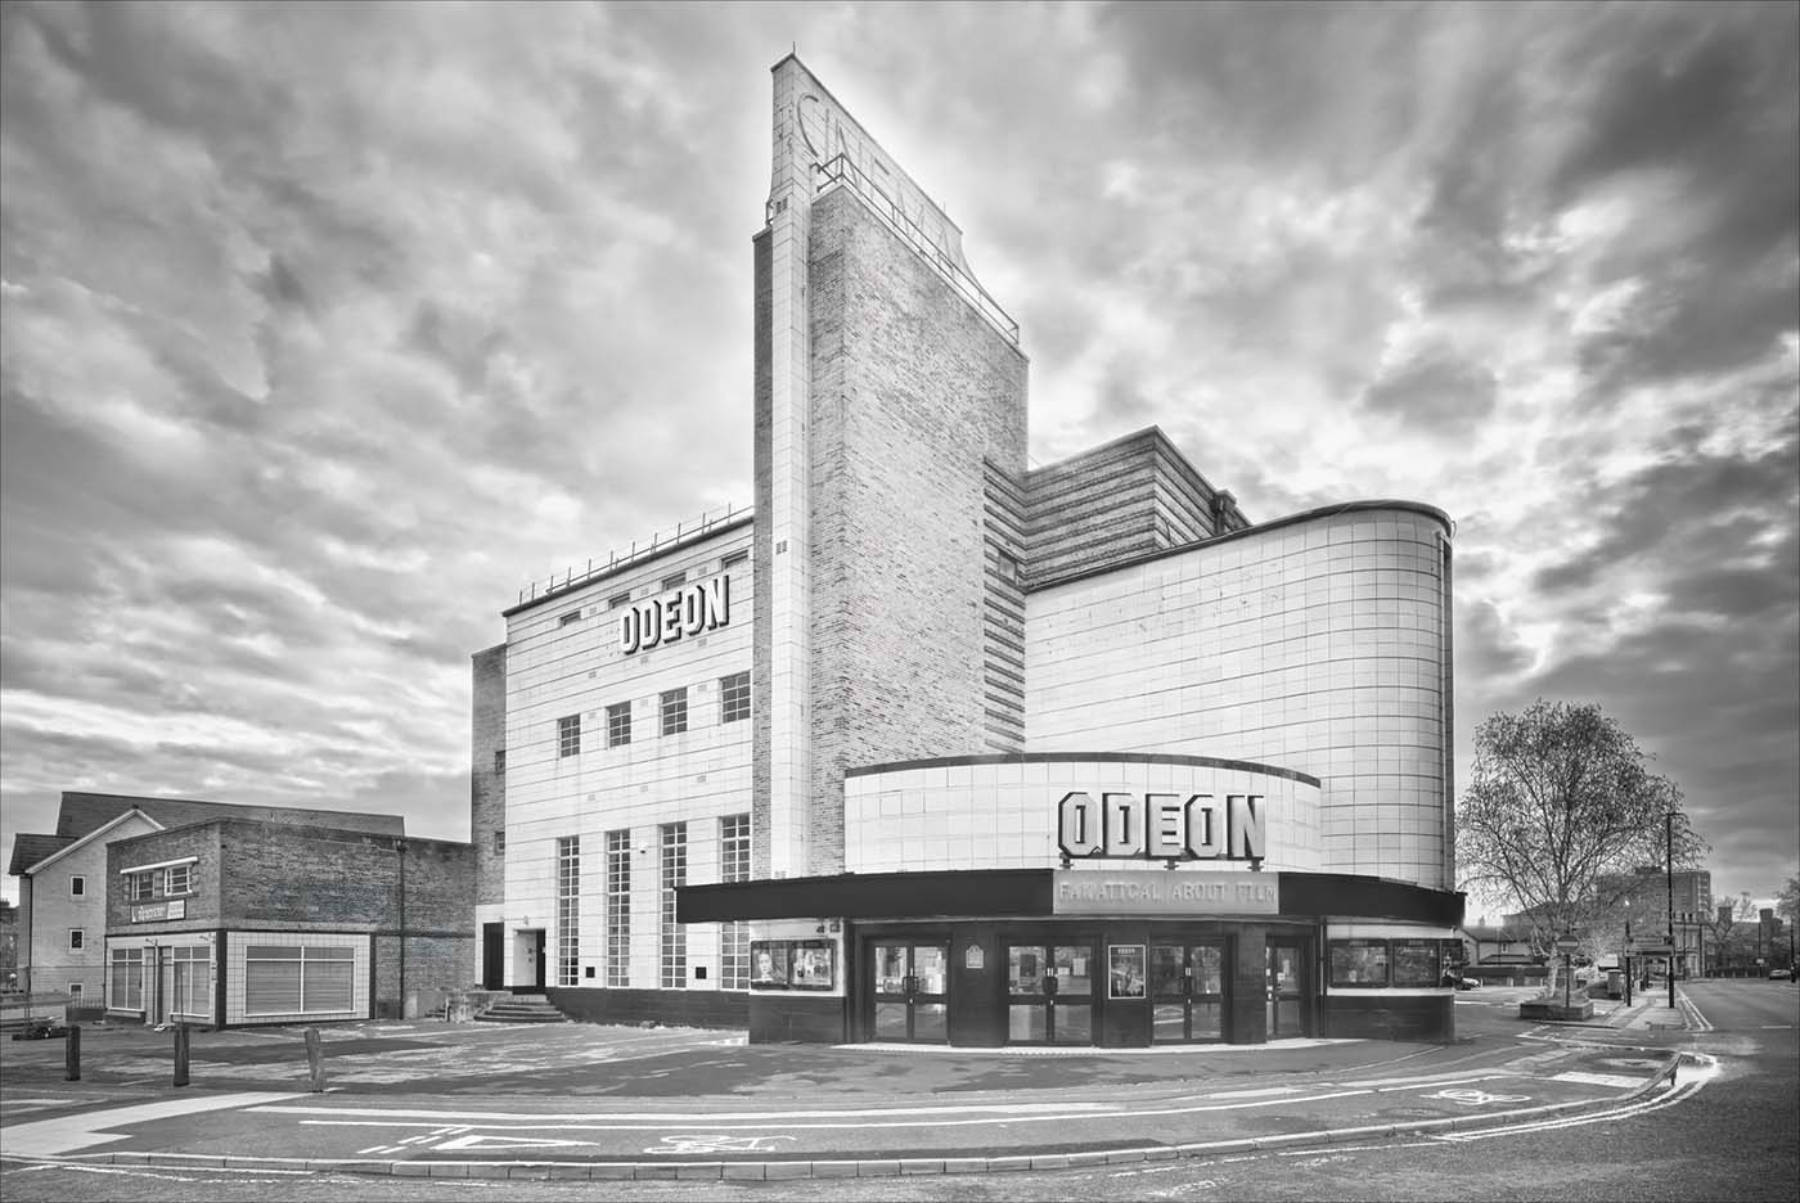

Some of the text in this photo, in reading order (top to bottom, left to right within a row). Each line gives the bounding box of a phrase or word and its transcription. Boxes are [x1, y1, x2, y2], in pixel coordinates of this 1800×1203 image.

[620, 575, 730, 655] ODEON
[1058, 792, 1266, 859] ODEON
[1059, 880, 1275, 903] FANATICAL ABOUT FILM
